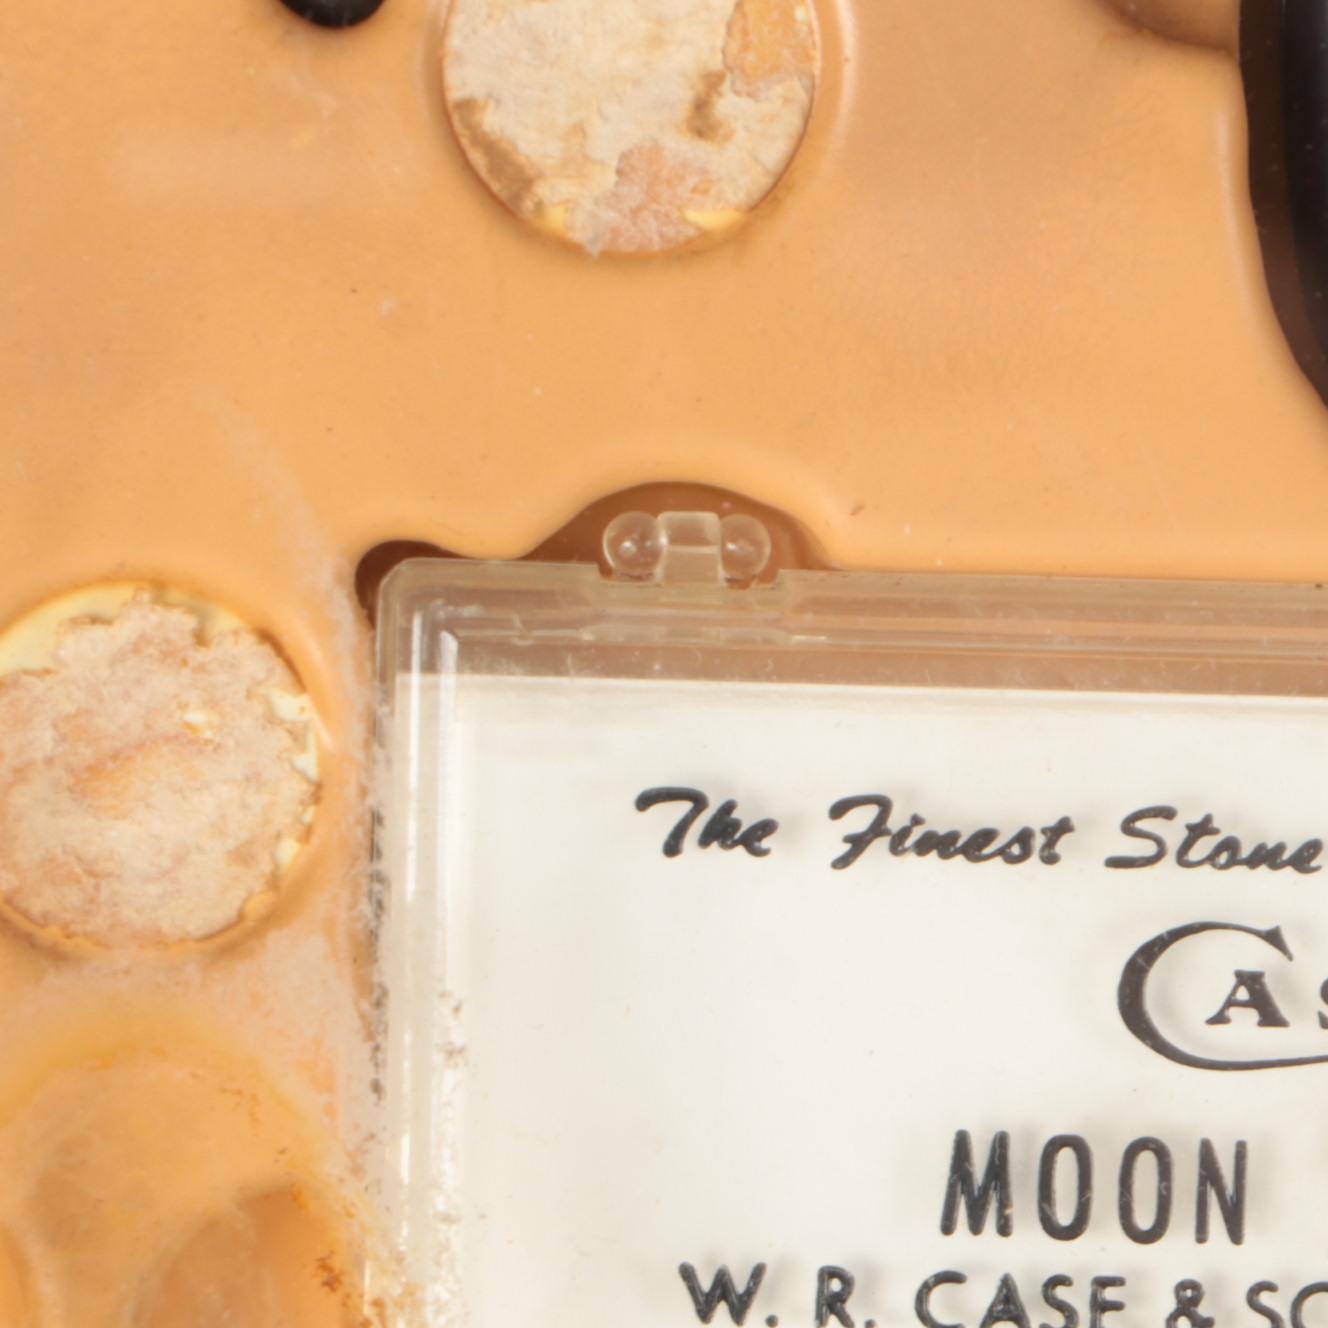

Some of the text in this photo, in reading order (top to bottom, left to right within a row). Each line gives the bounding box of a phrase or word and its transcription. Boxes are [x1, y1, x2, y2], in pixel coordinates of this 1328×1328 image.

[634, 786, 778, 858] The
[828, 794, 1075, 870] Finest
[1104, 805, 1323, 874] Stone
[940, 1129, 1247, 1246] MOON
[678, 1263, 778, 1328] W.
